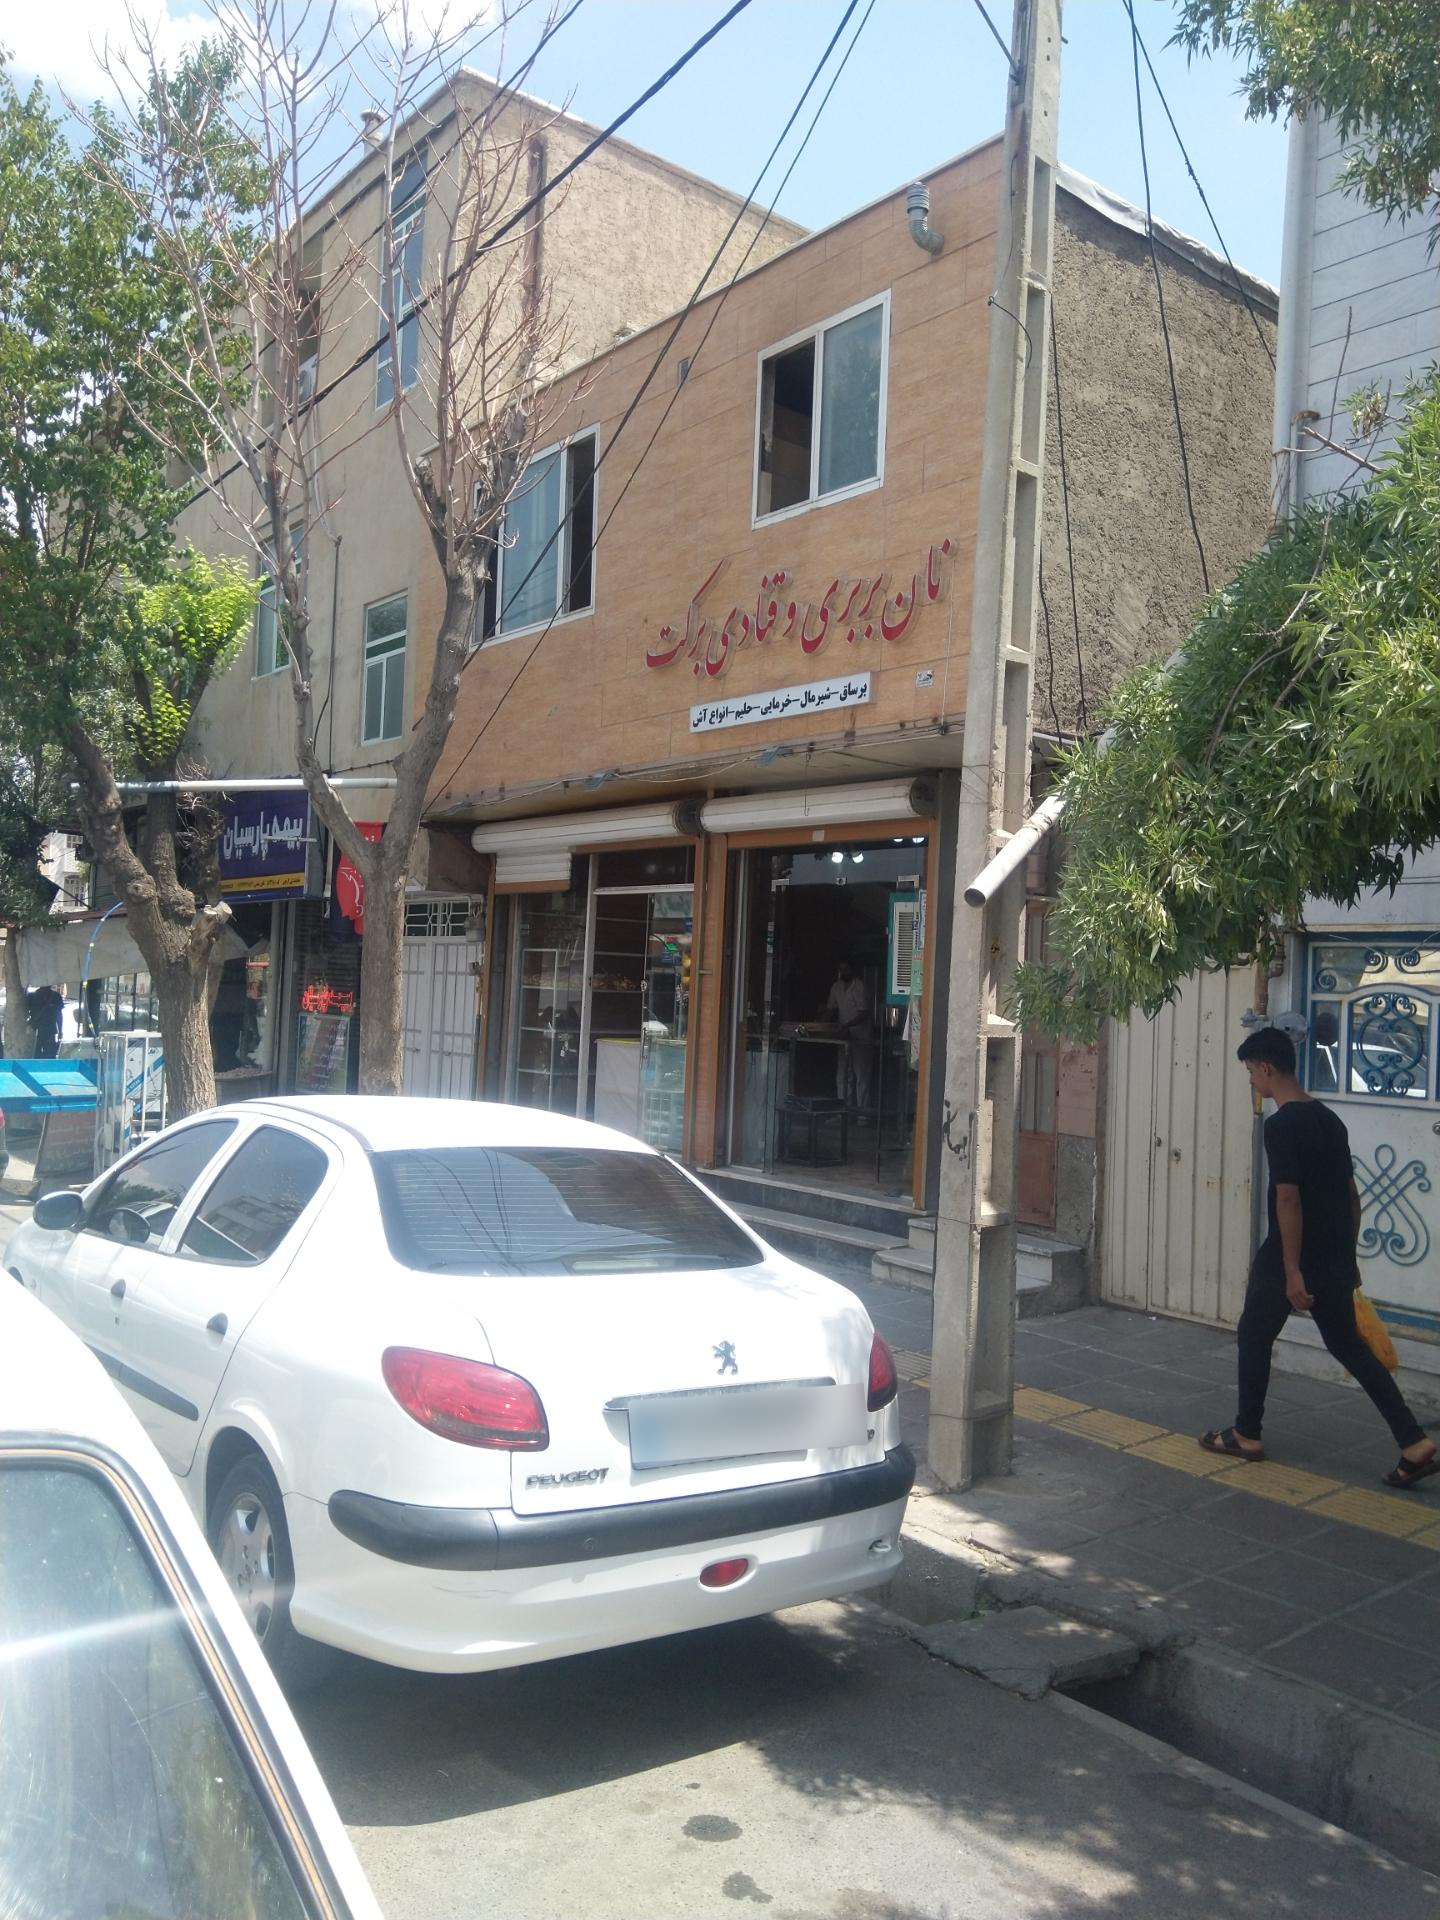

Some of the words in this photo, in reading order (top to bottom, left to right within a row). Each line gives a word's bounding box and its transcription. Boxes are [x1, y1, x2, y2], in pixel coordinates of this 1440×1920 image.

[645, 559, 725, 676] برکت
[782, 601, 798, 638] و
[801, 572, 884, 654] بربری
[881, 538, 950, 642] نان
[704, 571, 787, 677] قنادی
[223, 811, 270, 861] پارسیان
[271, 815, 304, 851] بیمه
[525, 1467, 610, 1489] PEUGEOT
